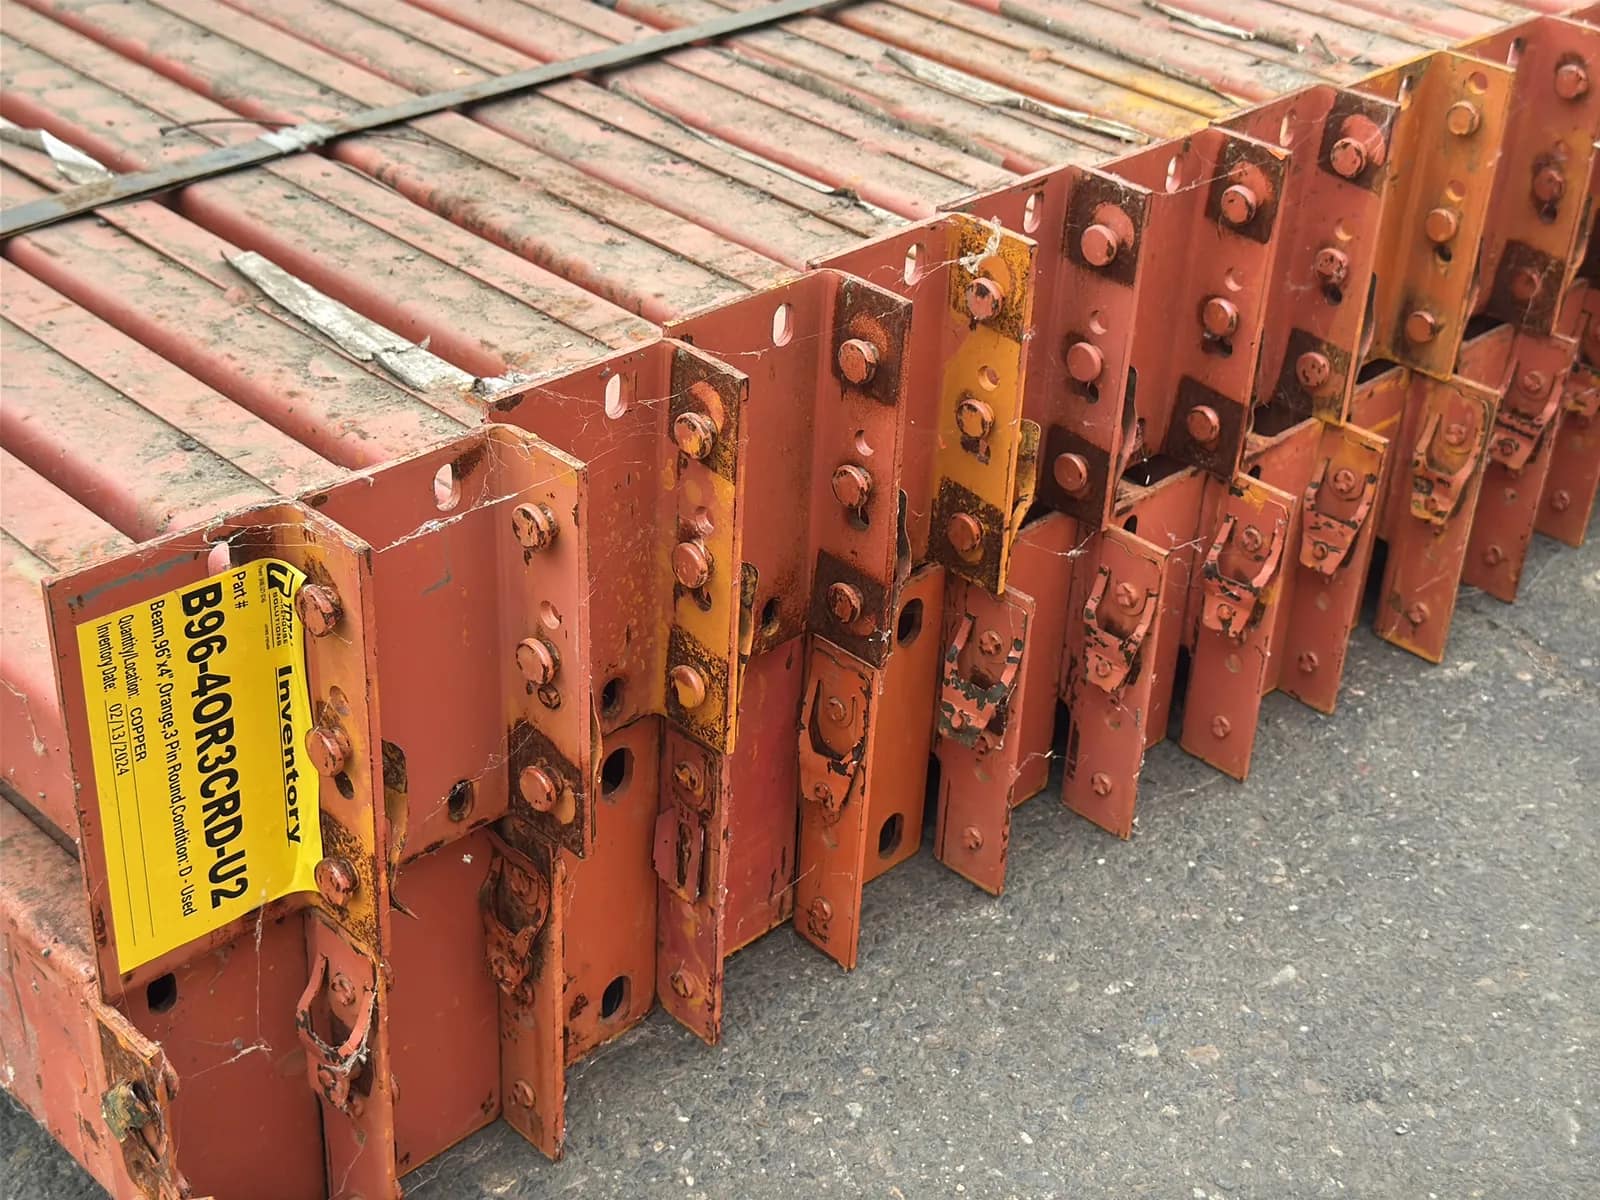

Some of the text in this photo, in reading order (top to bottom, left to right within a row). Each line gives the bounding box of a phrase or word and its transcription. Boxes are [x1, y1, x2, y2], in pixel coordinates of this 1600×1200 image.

[233, 571, 248, 609] Part #
[96, 622, 130, 776] Inventory Date: 02/13/2024
[118, 614, 147, 762] Quantity/Location: COPPER
[165, 740, 181, 763] Pin
[278, 665, 302, 843] Inventory
[168, 763, 191, 866] Round,Condition:
[179, 865, 193, 877] D
[180, 884, 197, 917] Used
